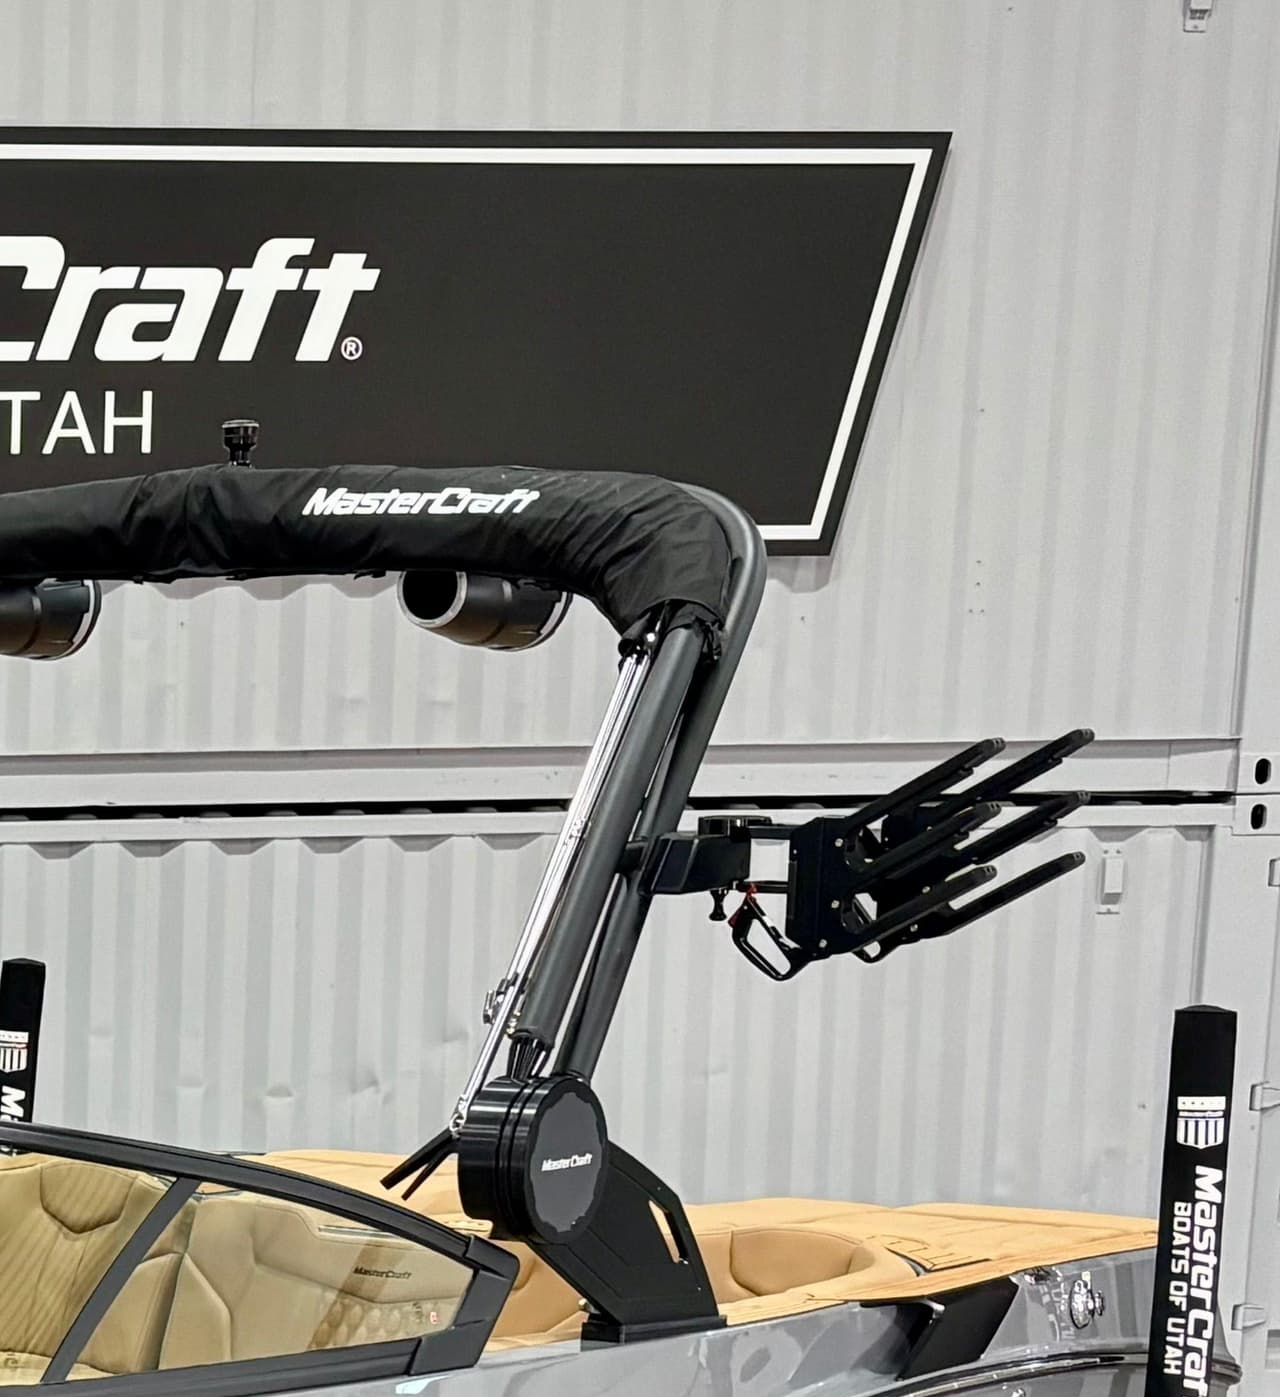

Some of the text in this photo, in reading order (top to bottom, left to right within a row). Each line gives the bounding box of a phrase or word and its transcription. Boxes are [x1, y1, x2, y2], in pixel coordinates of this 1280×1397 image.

[301, 487, 541, 516] MasterCraft
[1162, 1201, 1192, 1375] BOATS OF UTAH
